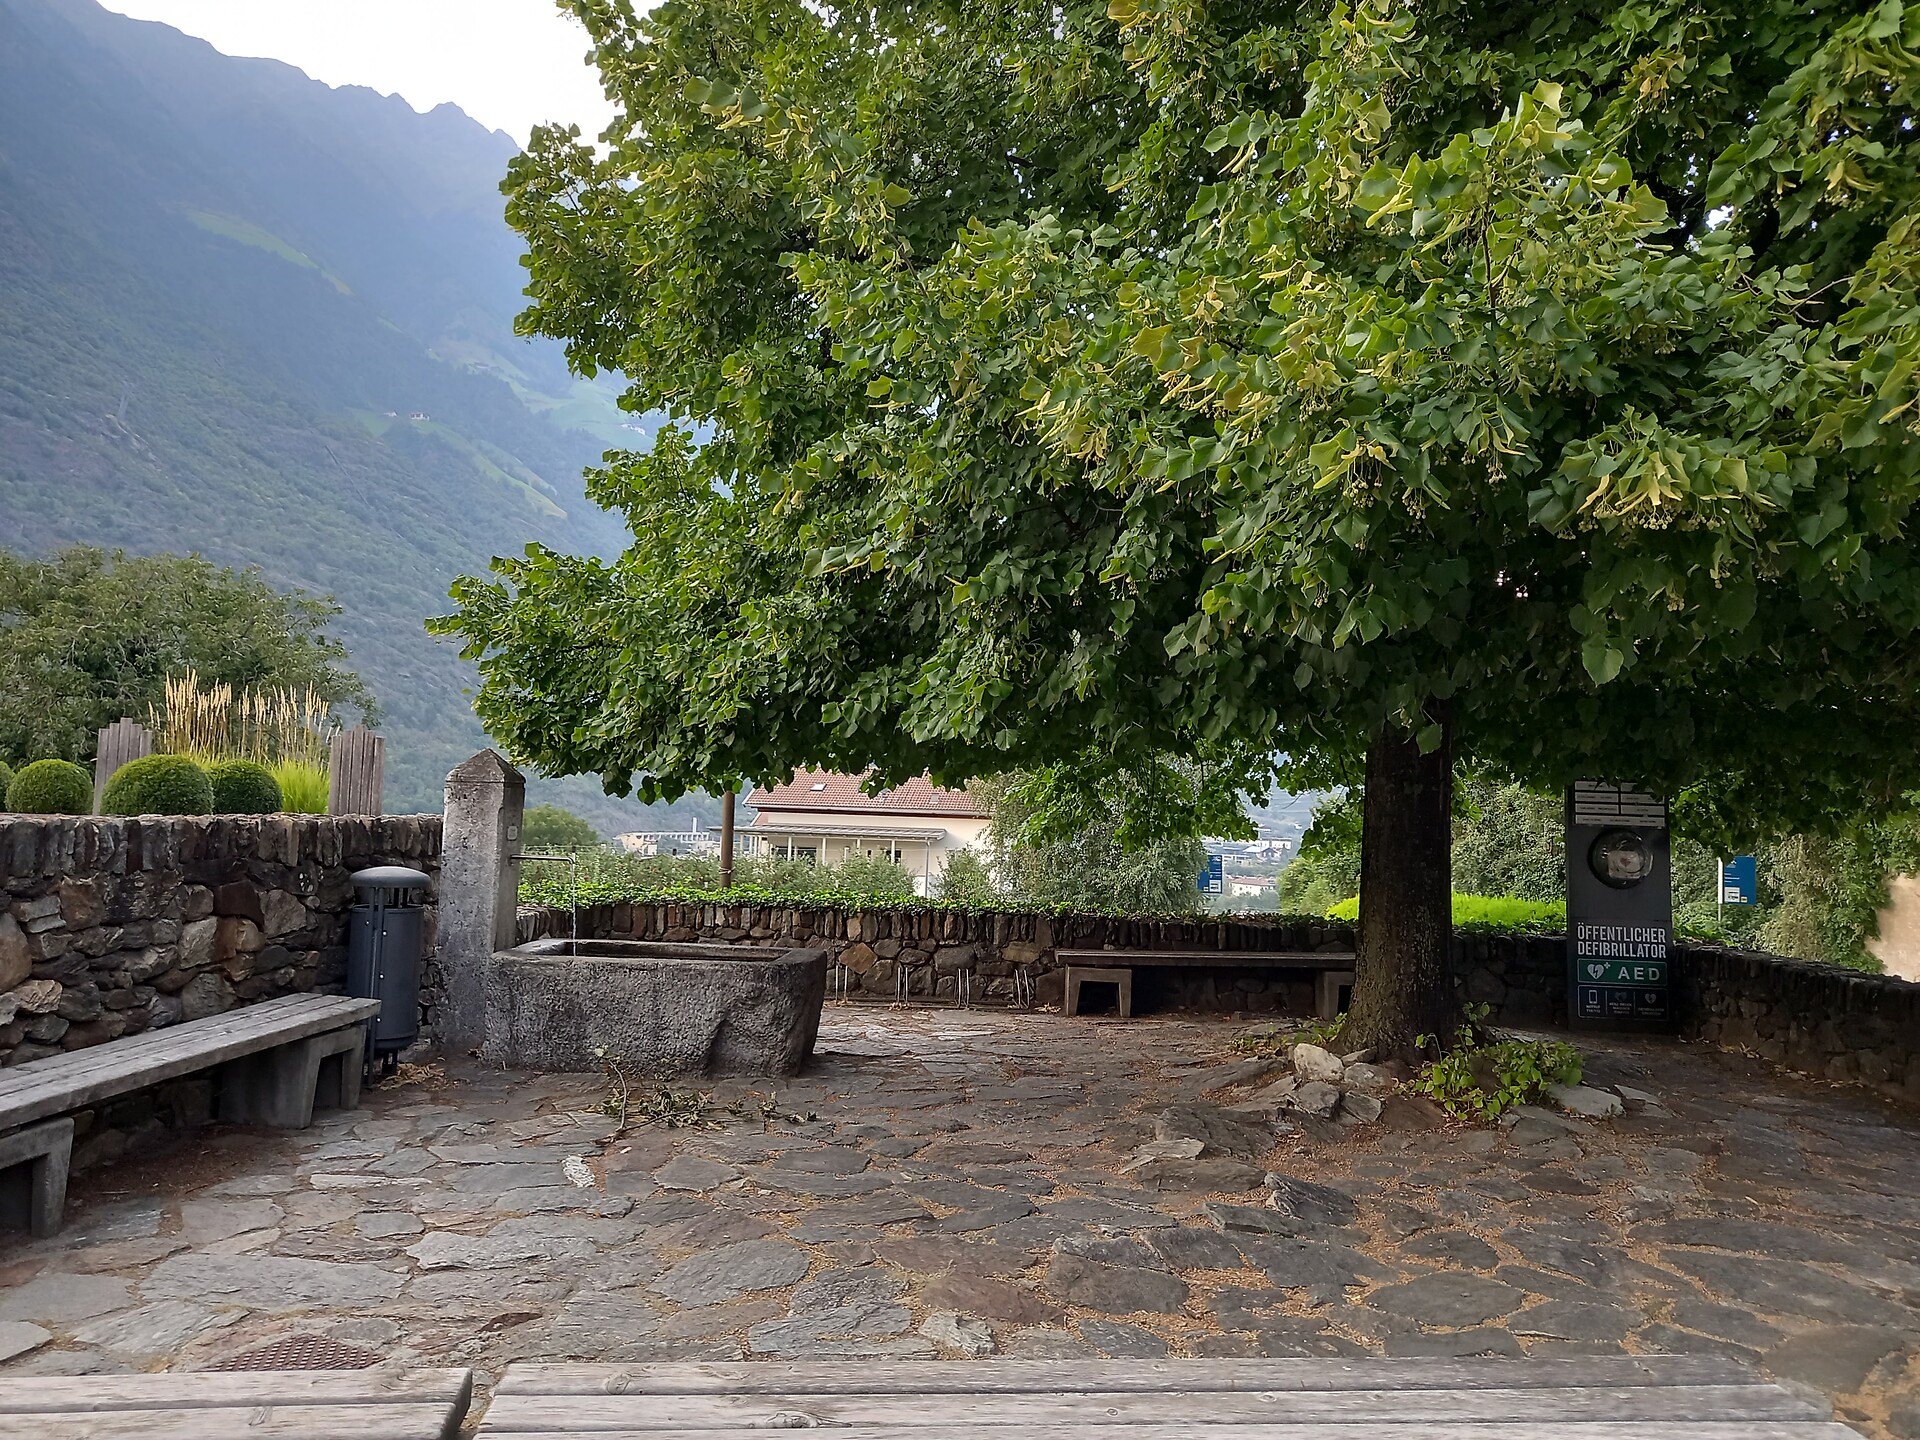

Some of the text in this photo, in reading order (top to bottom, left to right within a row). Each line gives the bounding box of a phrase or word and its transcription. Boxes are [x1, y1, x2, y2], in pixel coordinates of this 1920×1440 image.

[1577, 922, 1666, 943] ÖFFENTLICHER
[1577, 941, 1667, 958] DEFIBRILLATOR
[1617, 966, 1660, 980] AED
